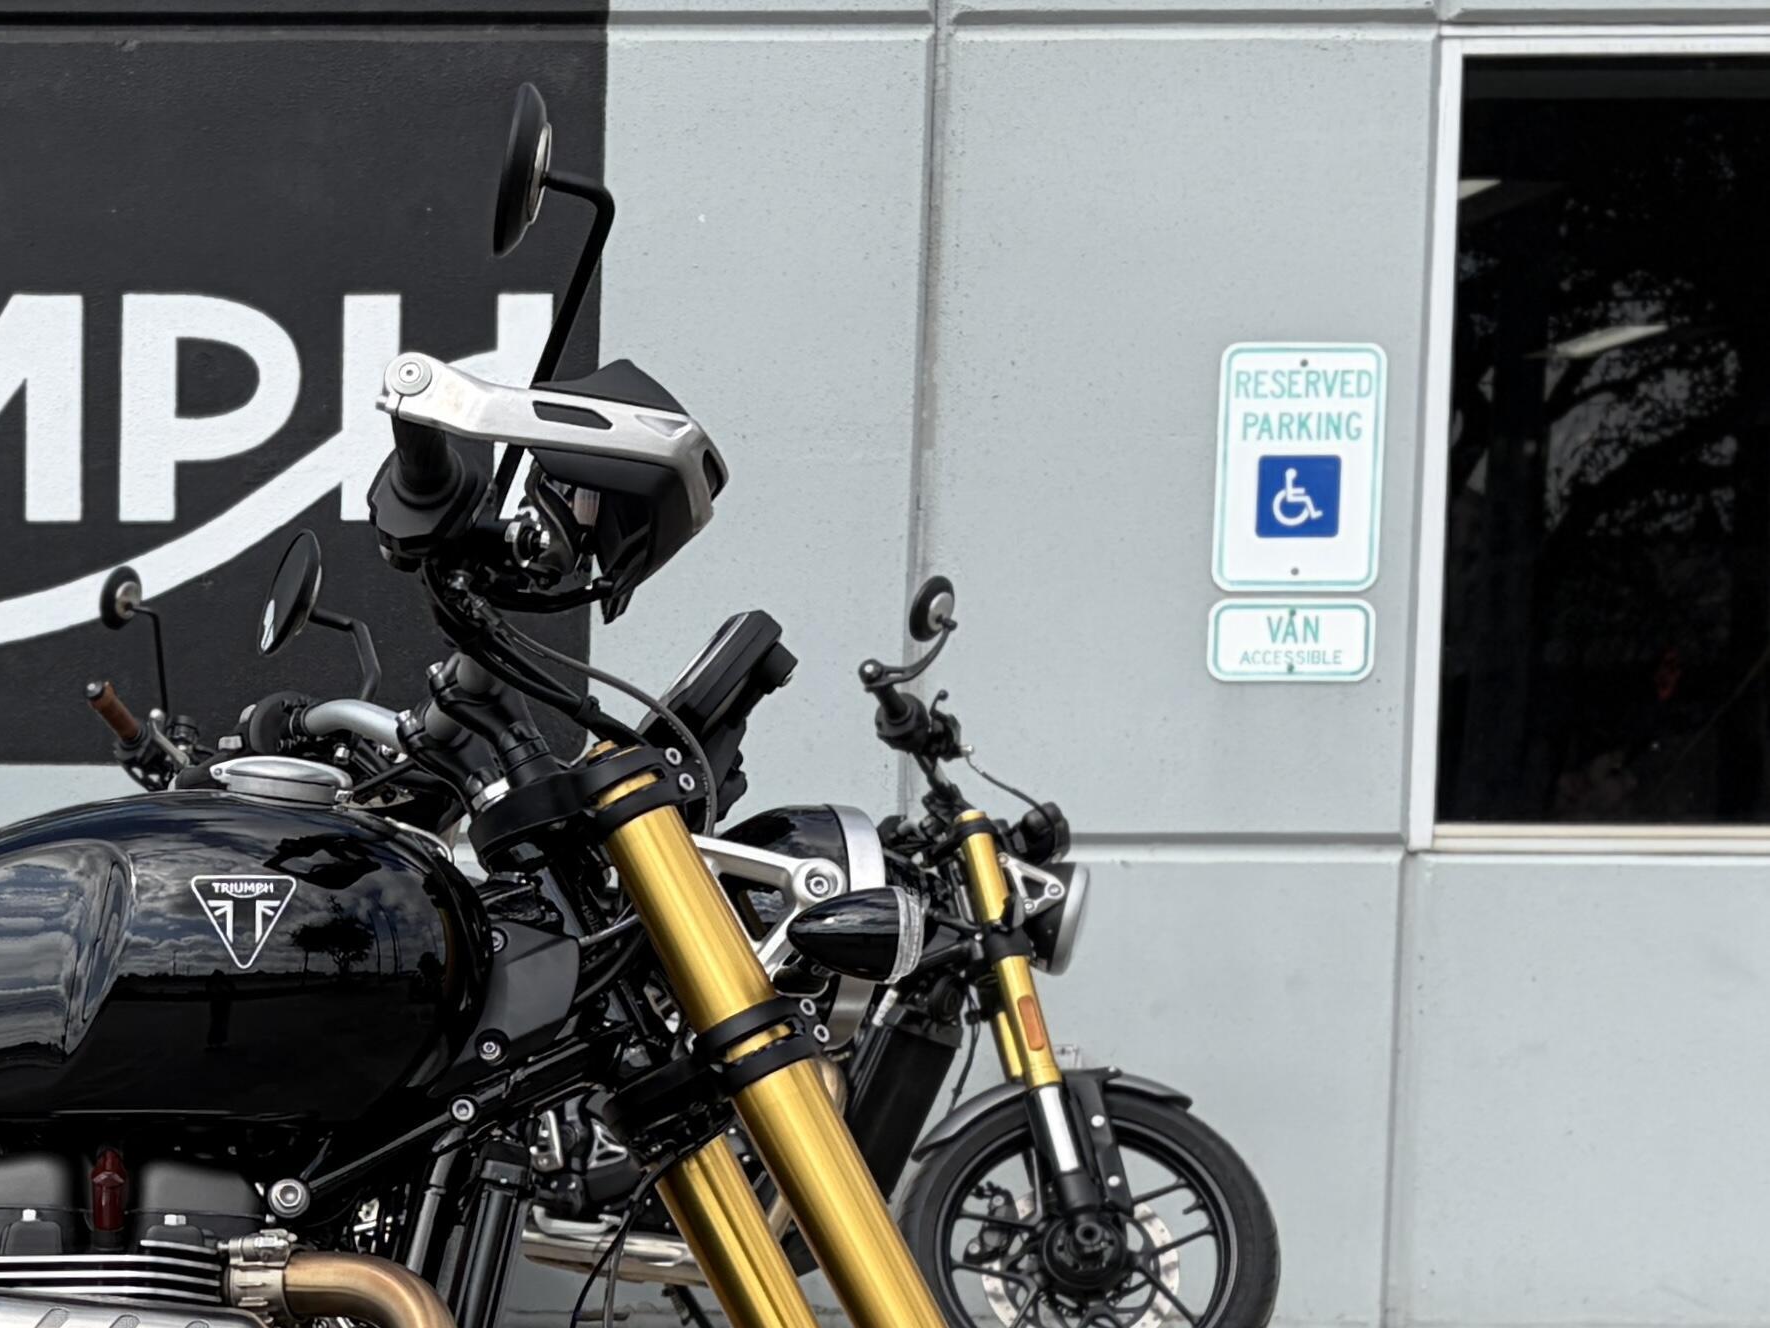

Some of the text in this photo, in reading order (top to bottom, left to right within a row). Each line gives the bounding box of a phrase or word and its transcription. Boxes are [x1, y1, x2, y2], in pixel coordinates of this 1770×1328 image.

[1234, 369, 1373, 399] RESERVED
[1242, 411, 1363, 441] PARKING
[1267, 616, 1320, 644] VAN
[1239, 650, 1343, 666] ACCESSIBLE
[212, 882, 274, 898] TRIUMPH
